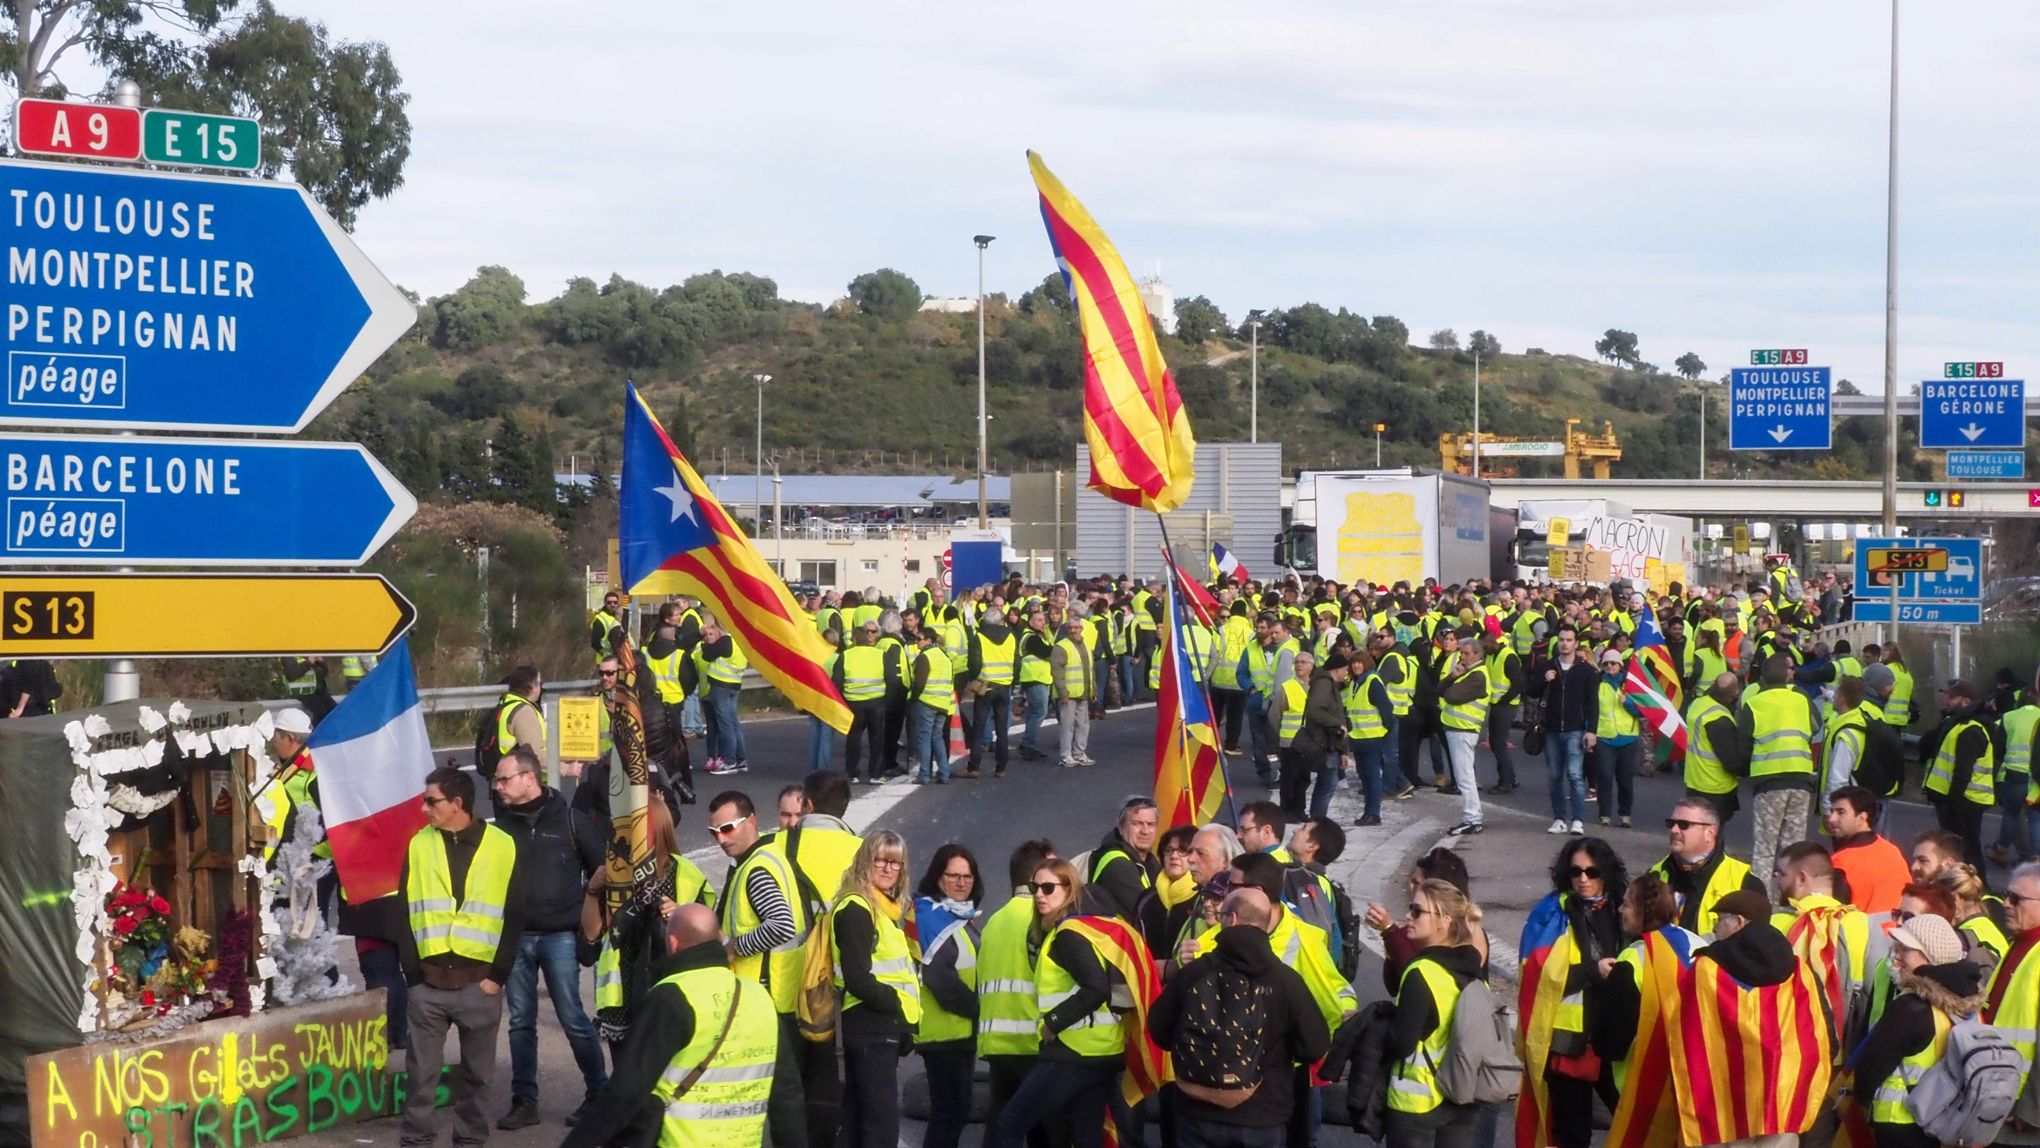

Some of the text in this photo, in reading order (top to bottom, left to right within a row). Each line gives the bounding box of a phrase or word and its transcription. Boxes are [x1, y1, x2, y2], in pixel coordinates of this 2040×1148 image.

[51, 110, 108, 150] A 9
[165, 119, 237, 161] E 15
[11, 189, 215, 240] TOULOUSE
[9, 247, 255, 298] MONTPELLIER
[8, 304, 237, 352] PERPIGNAN
[1752, 351, 1779, 363] E 15
[1785, 351, 1804, 363] A 9
[1946, 364, 1973, 376] E 15
[1980, 364, 2000, 376] A 9
[18, 356, 118, 404] péage
[1741, 371, 1820, 384] TOULOUSE
[1736, 387, 1825, 400] MONTPELLIER
[1926, 384, 2019, 398] BARCELONE
[1736, 403, 1825, 416] PERPIGNAN
[1940, 399, 2005, 414] GÉRONE
[1503, 443, 1549, 451] AMBROGIO
[1950, 455, 2021, 464] MONTPELLIER
[7, 453, 241, 495] BARCELONE
[1951, 465, 2002, 474] TOULOUSE
[16, 502, 117, 548] péage
[1586, 516, 1665, 558] MACRON
[1891, 553, 1924, 568] S 13
[1934, 586, 1964, 594] Ticket
[12, 596, 86, 635] S 13
[1926, 610, 1939, 620] m
[48, 1061, 78, 1127] A
[95, 1048, 170, 1116] NOS
[295, 1014, 388, 1073] JAUNES
